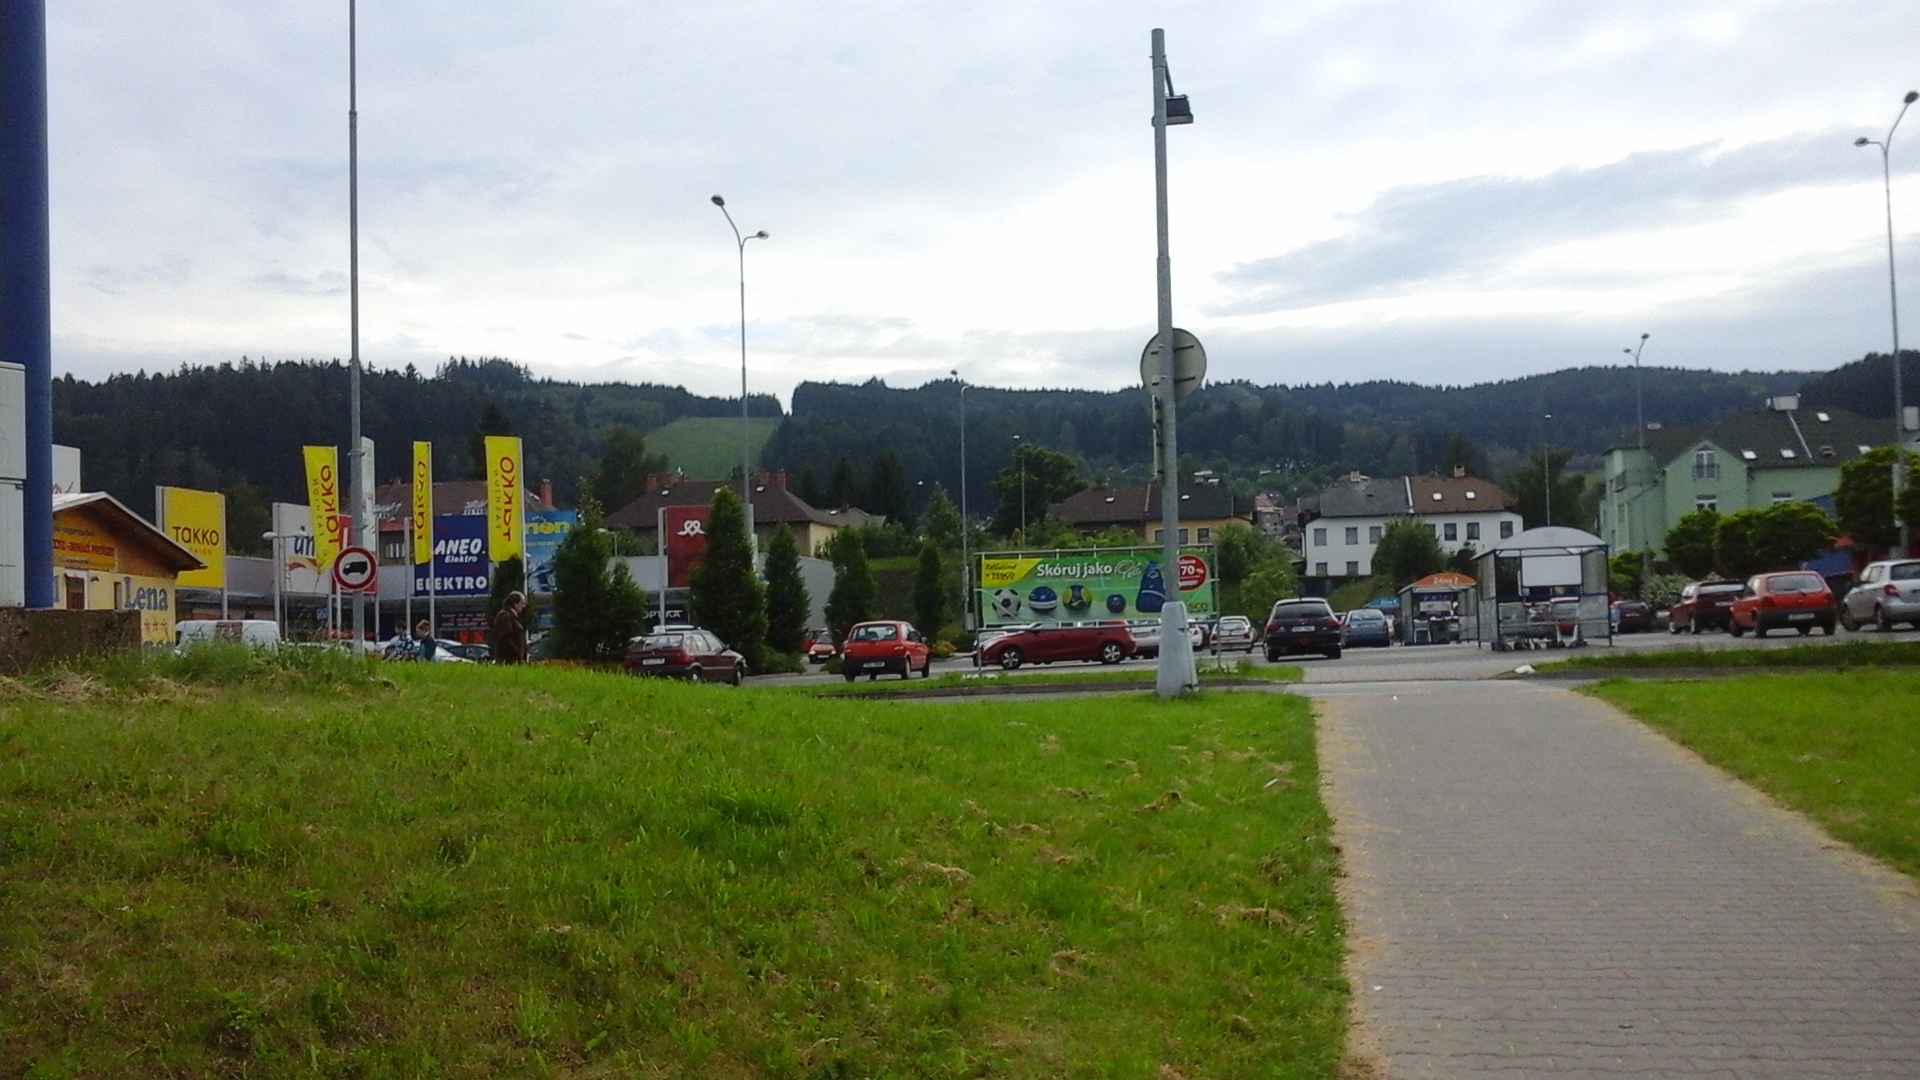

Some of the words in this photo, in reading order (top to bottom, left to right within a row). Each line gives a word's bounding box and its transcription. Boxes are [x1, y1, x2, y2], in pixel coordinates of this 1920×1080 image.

[445, 555, 478, 563] Elektro
[1036, 562, 1081, 579] Skóruj
[1082, 563, 1113, 578] jako
[124, 577, 169, 612] Lena
